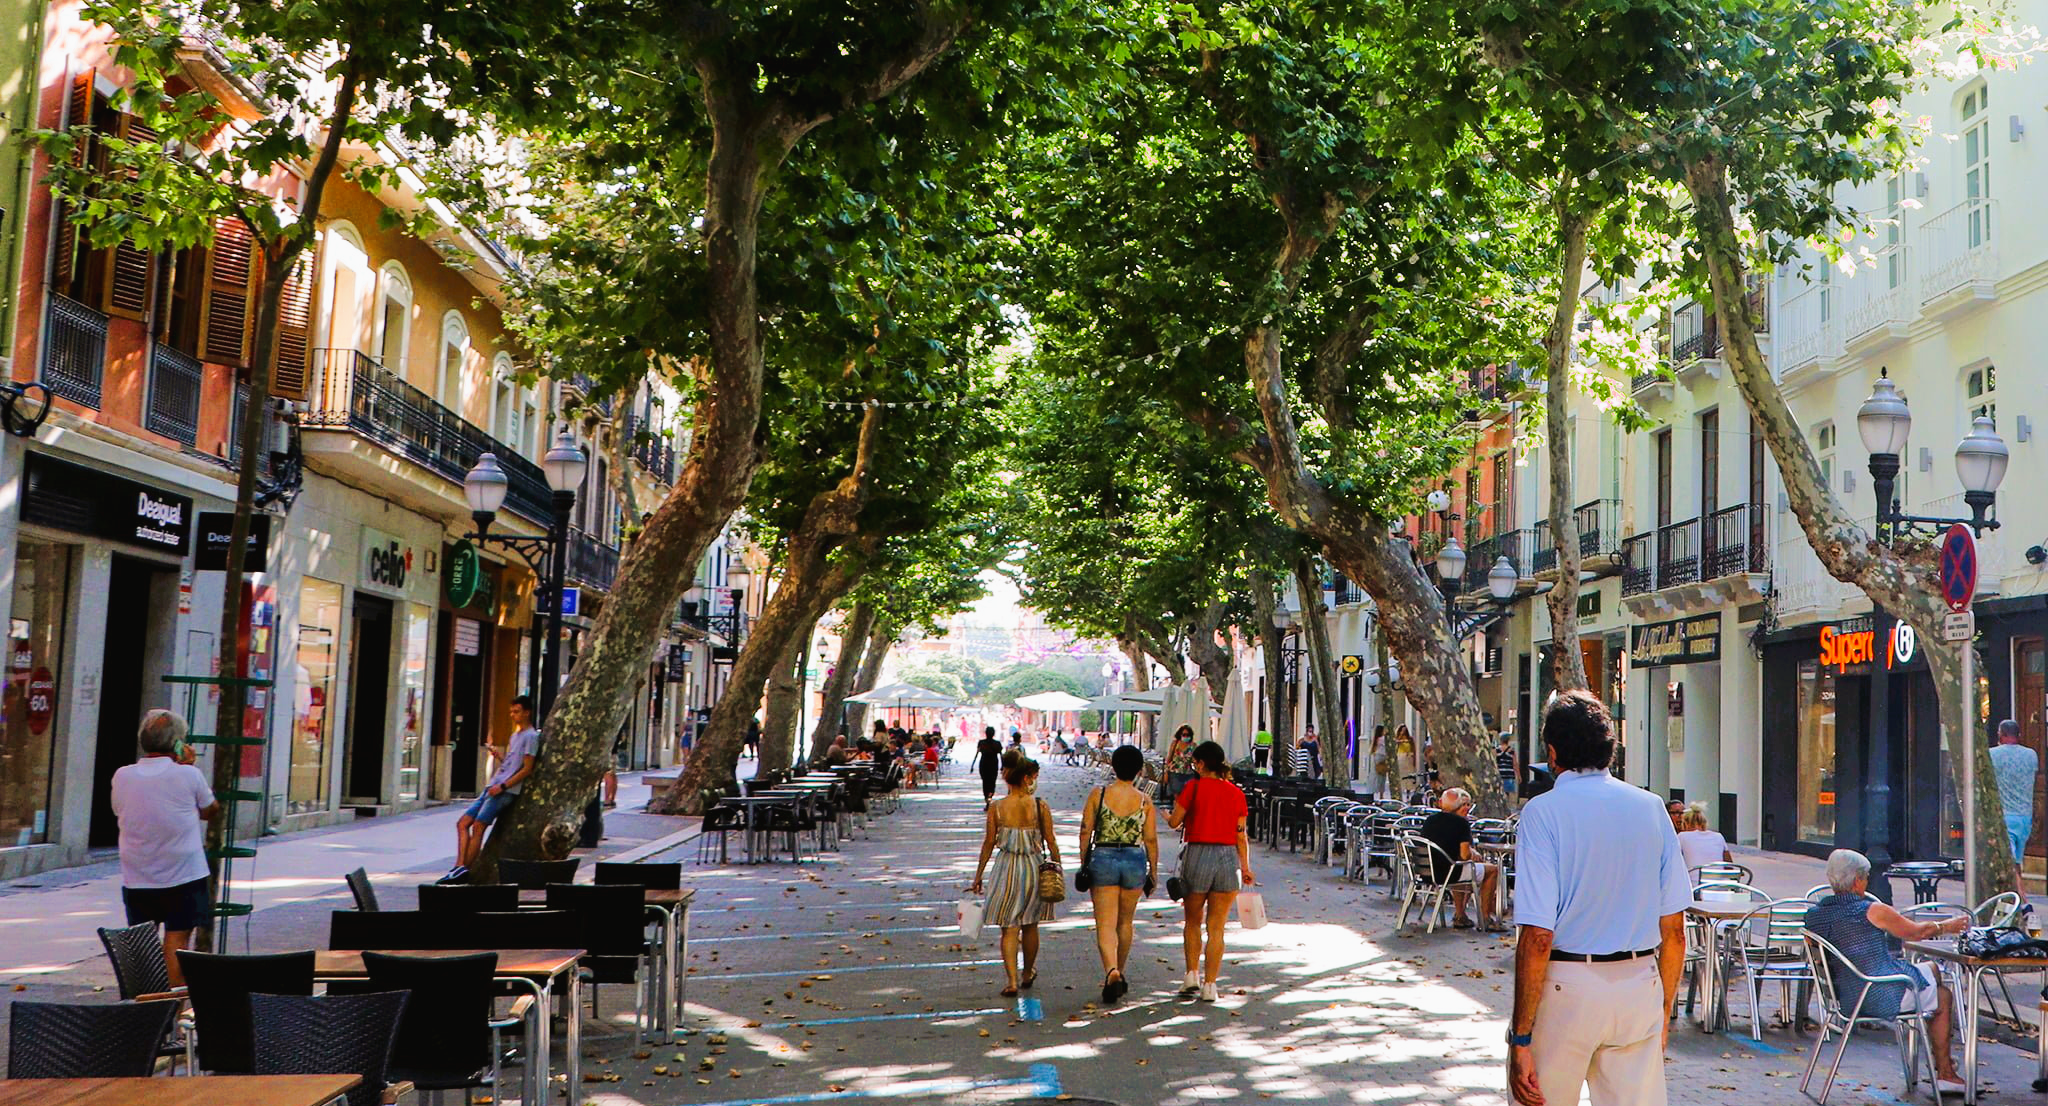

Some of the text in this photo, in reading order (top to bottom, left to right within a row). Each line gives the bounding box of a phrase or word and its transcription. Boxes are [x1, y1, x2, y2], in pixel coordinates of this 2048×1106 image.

[137, 491, 182, 526] Desigual
[207, 532, 257, 544] Desal
[371, 541, 405, 588] celio
[1820, 625, 1896, 675] Supery
